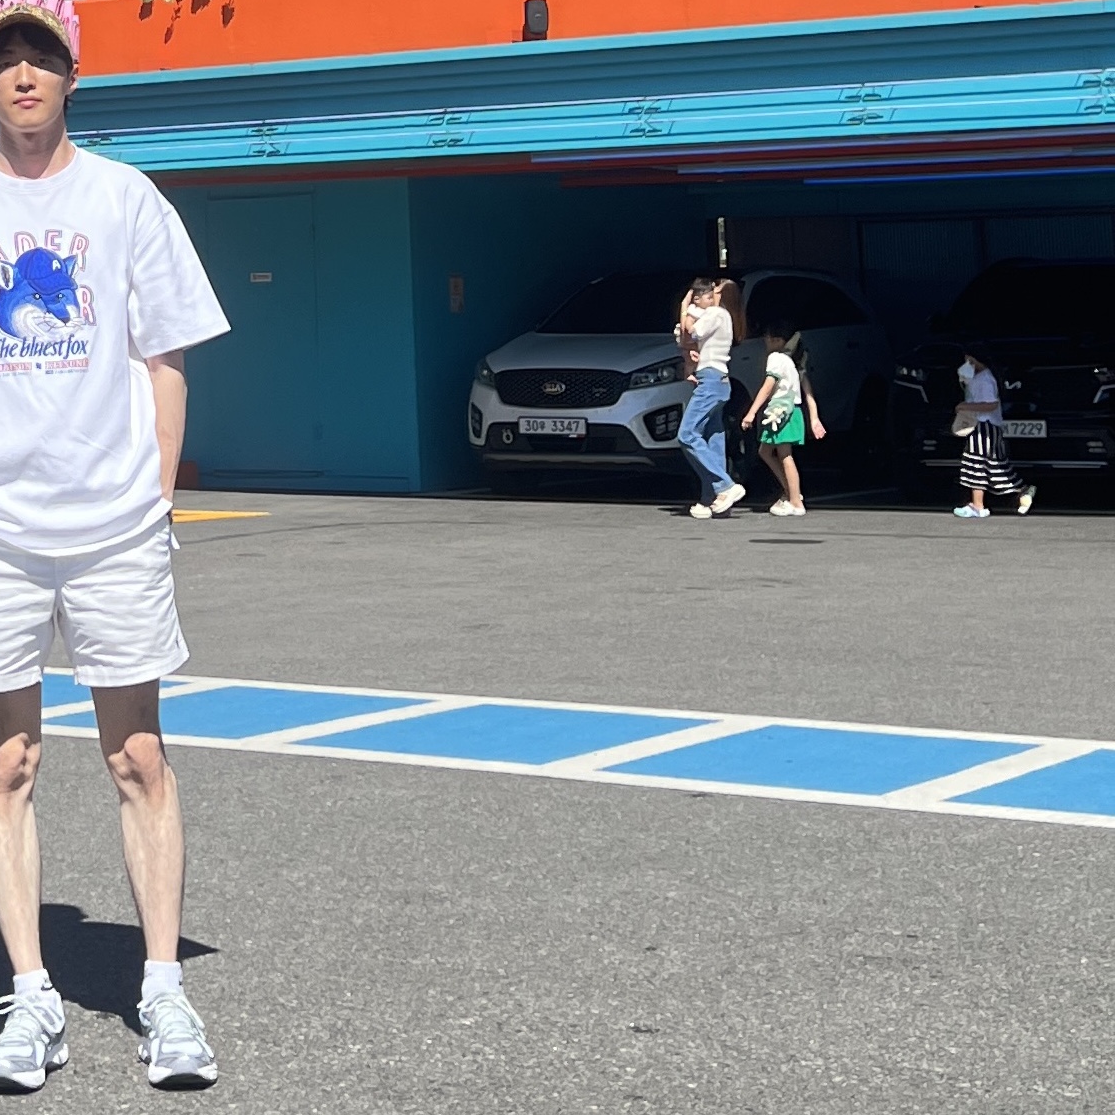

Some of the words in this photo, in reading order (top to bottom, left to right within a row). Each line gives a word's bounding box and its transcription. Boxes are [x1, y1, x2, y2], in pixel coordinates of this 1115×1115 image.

[19, 335, 66, 358] bluest
[62, 332, 89, 360] fox
[551, 420, 580, 432] 3347
[1011, 422, 1043, 435] 7229
